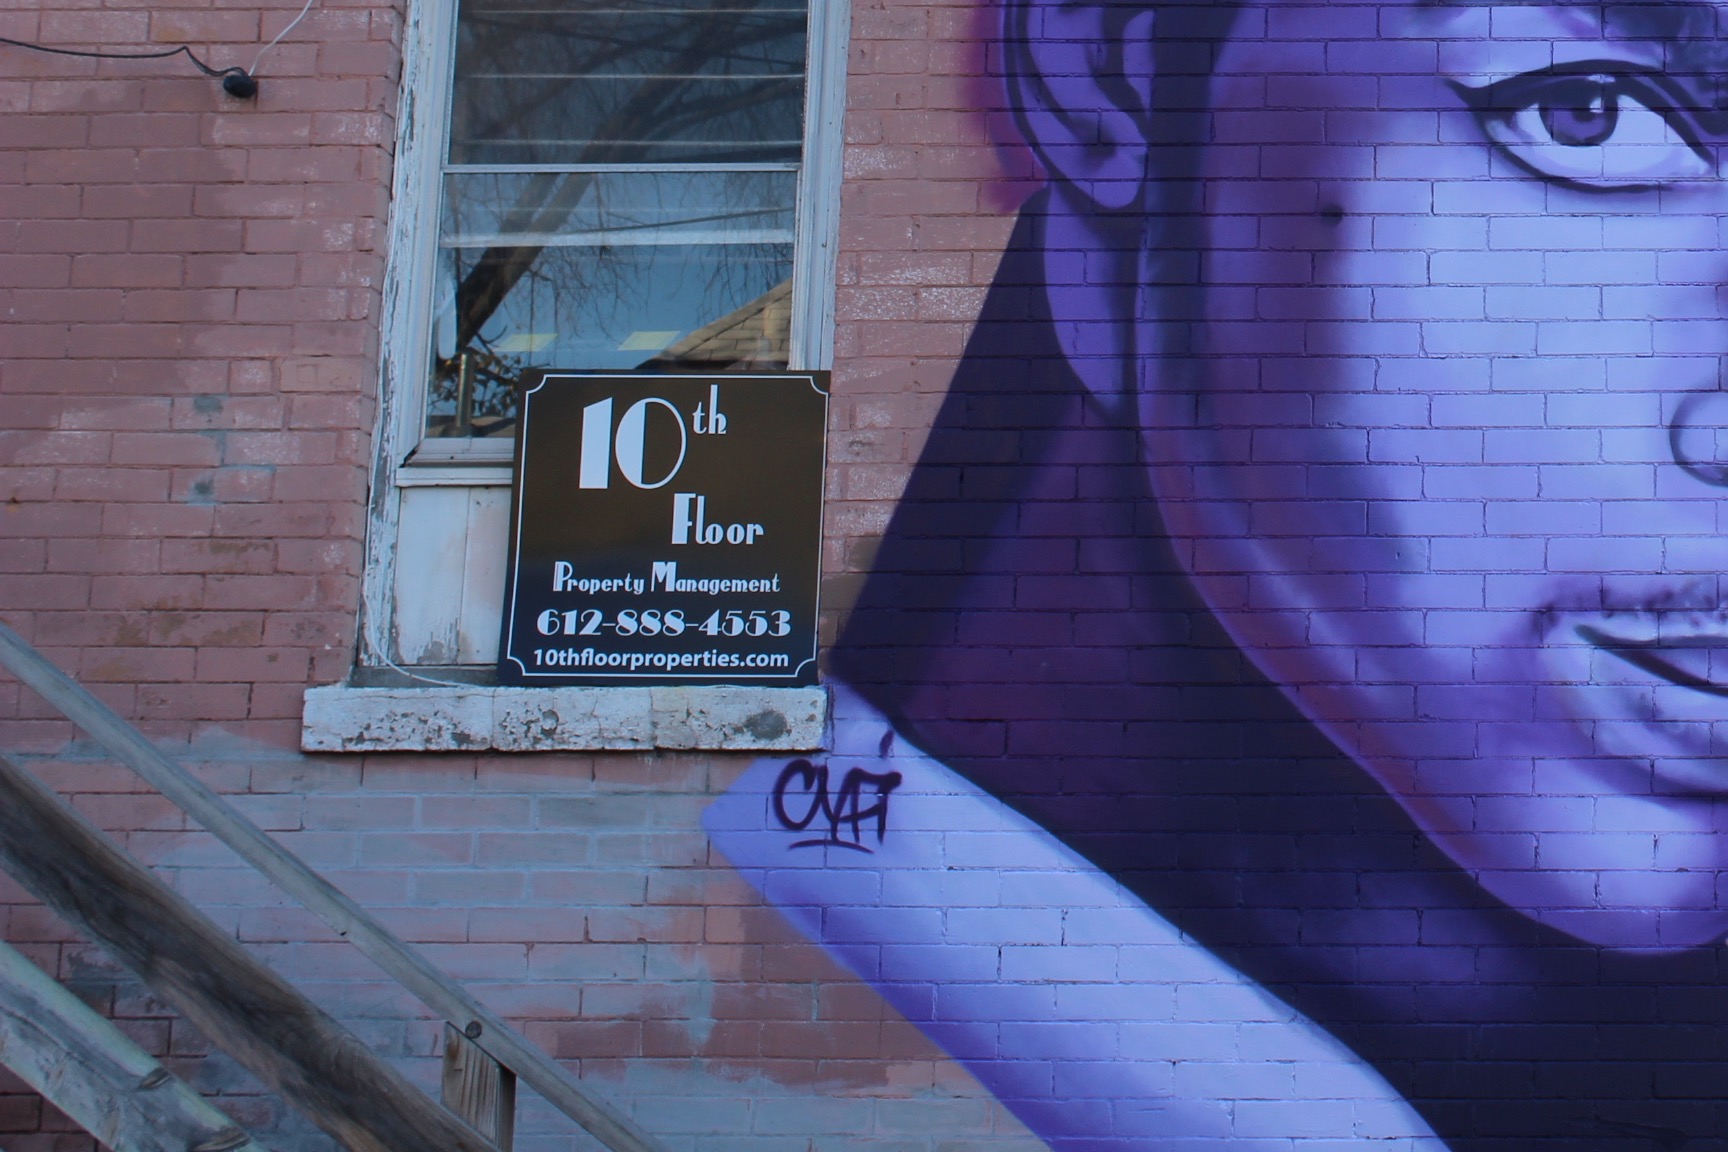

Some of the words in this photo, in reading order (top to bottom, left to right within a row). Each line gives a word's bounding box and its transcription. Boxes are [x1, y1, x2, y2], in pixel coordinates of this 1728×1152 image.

[578, 384, 728, 490] 10th
[671, 492, 765, 545] Floor
[552, 560, 645, 595] Property
[650, 560, 781, 595] Management
[536, 608, 792, 637] 612-888-4553
[533, 648, 790, 671] 10thfloorproperties.com
